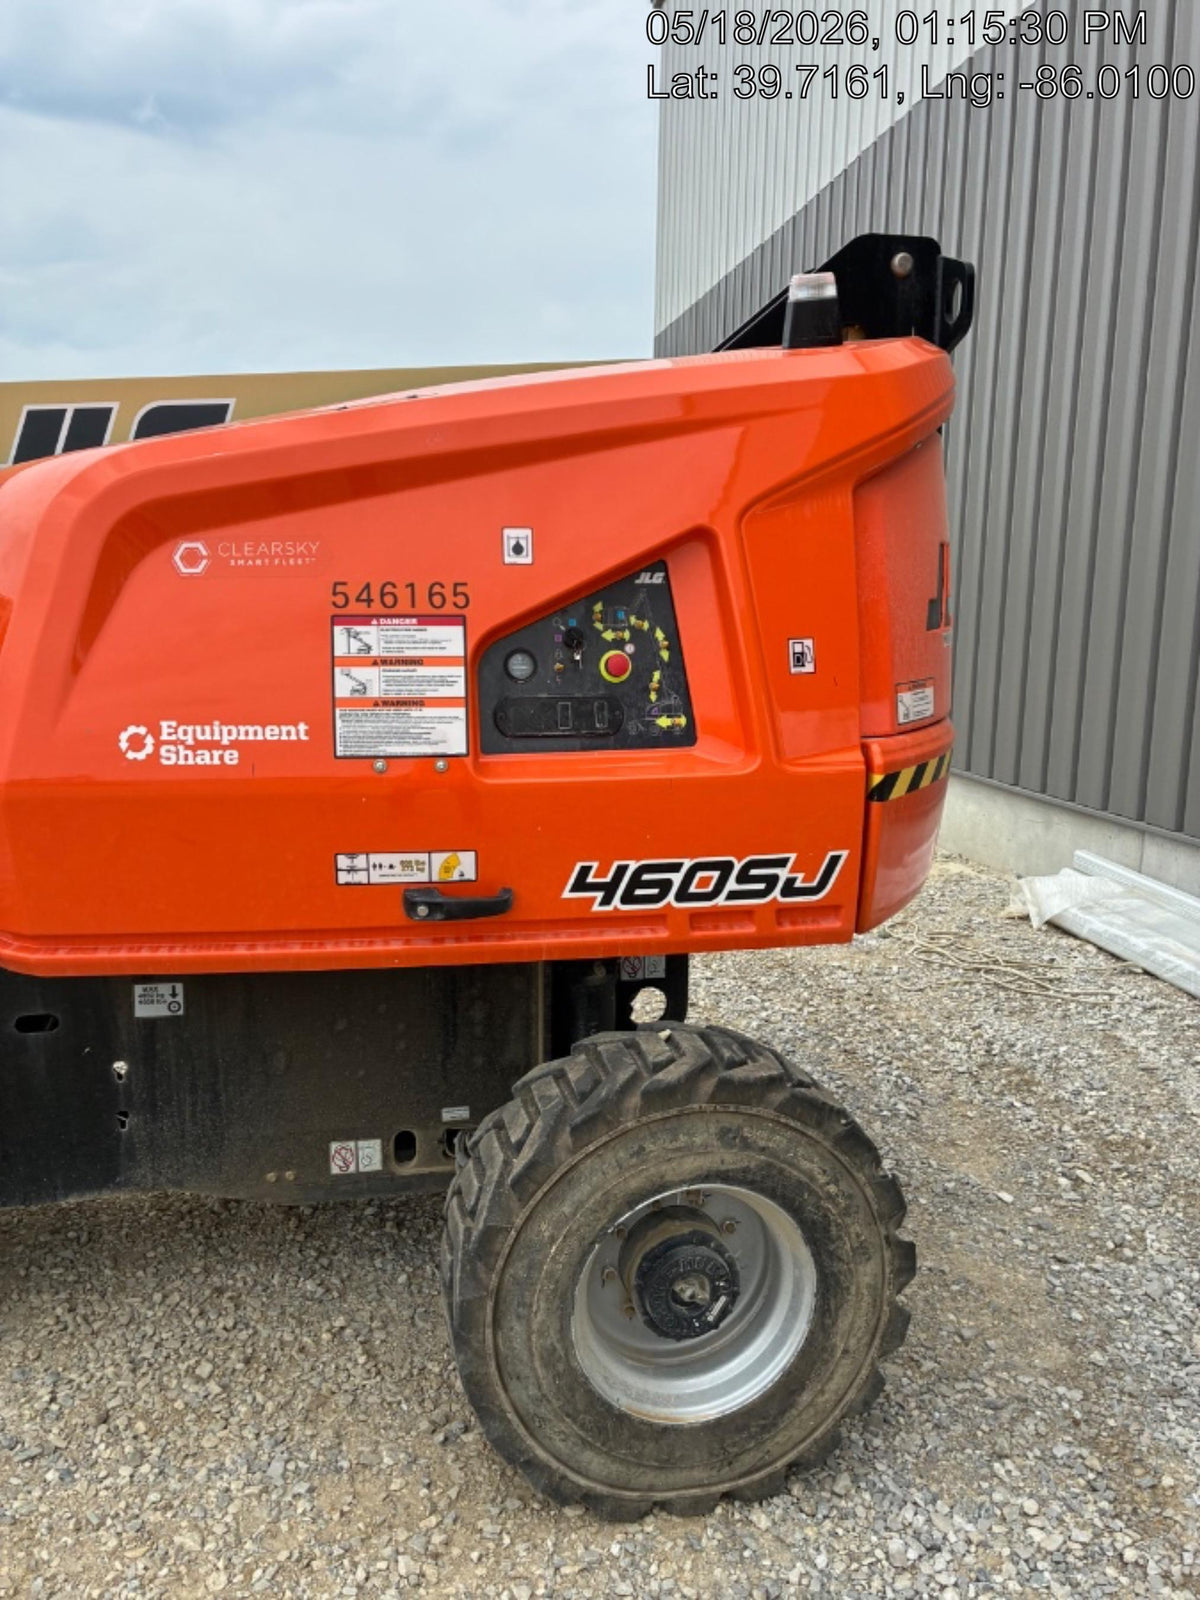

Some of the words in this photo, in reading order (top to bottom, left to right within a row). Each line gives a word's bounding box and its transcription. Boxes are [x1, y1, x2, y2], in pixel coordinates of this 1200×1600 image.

[217, 541, 320, 557] CLEARSKY
[229, 558, 270, 566] SMART
[634, 571, 665, 584] JLG
[331, 581, 470, 609] 546165
[380, 658, 424, 666] WARNING
[381, 699, 425, 707] WARNING
[159, 720, 309, 745] Equipment
[159, 744, 239, 765] Share
[561, 849, 850, 911] 460SJ
